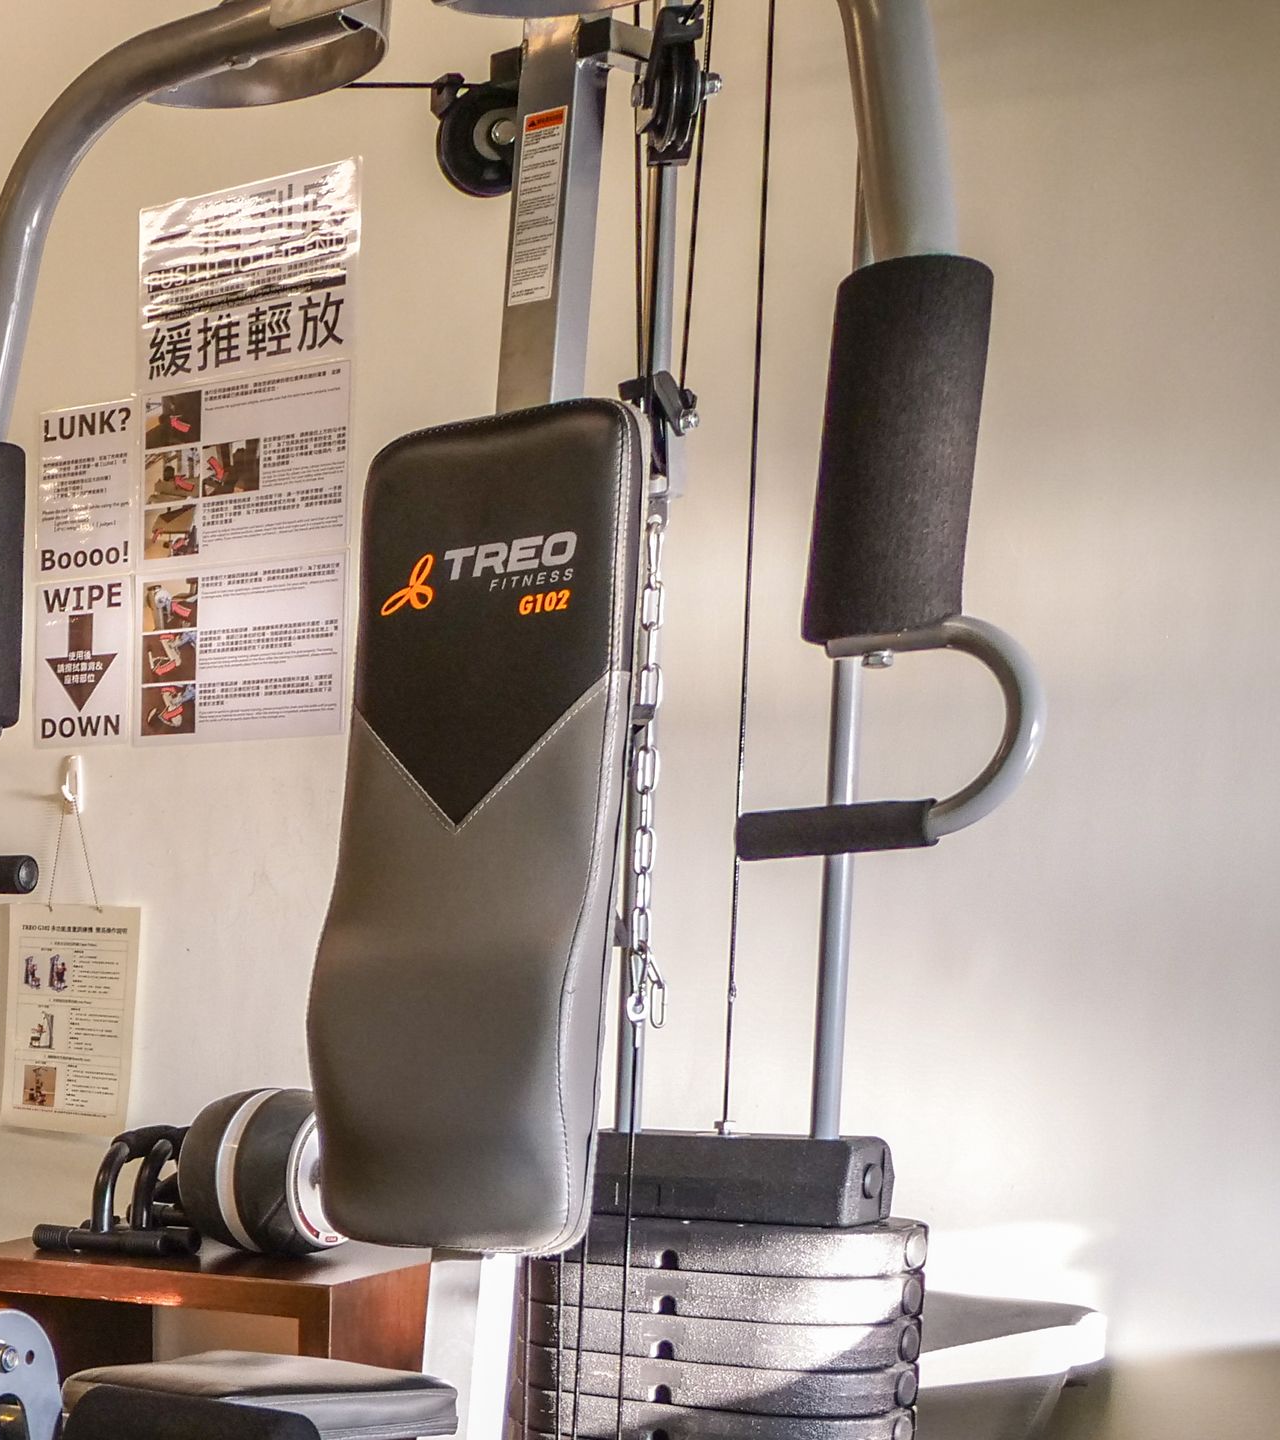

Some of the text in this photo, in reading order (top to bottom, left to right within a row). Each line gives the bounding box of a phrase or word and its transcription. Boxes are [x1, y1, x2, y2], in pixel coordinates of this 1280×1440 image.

[148, 292, 345, 381] 緩推輕放
[43, 406, 131, 443] LUNK?
[41, 540, 129, 572] Boooo!
[443, 530, 578, 581] TREO
[488, 567, 574, 592] FITNESS
[43, 582, 122, 614] WIPE
[518, 589, 571, 616] G102
[41, 714, 120, 740] DOWN
